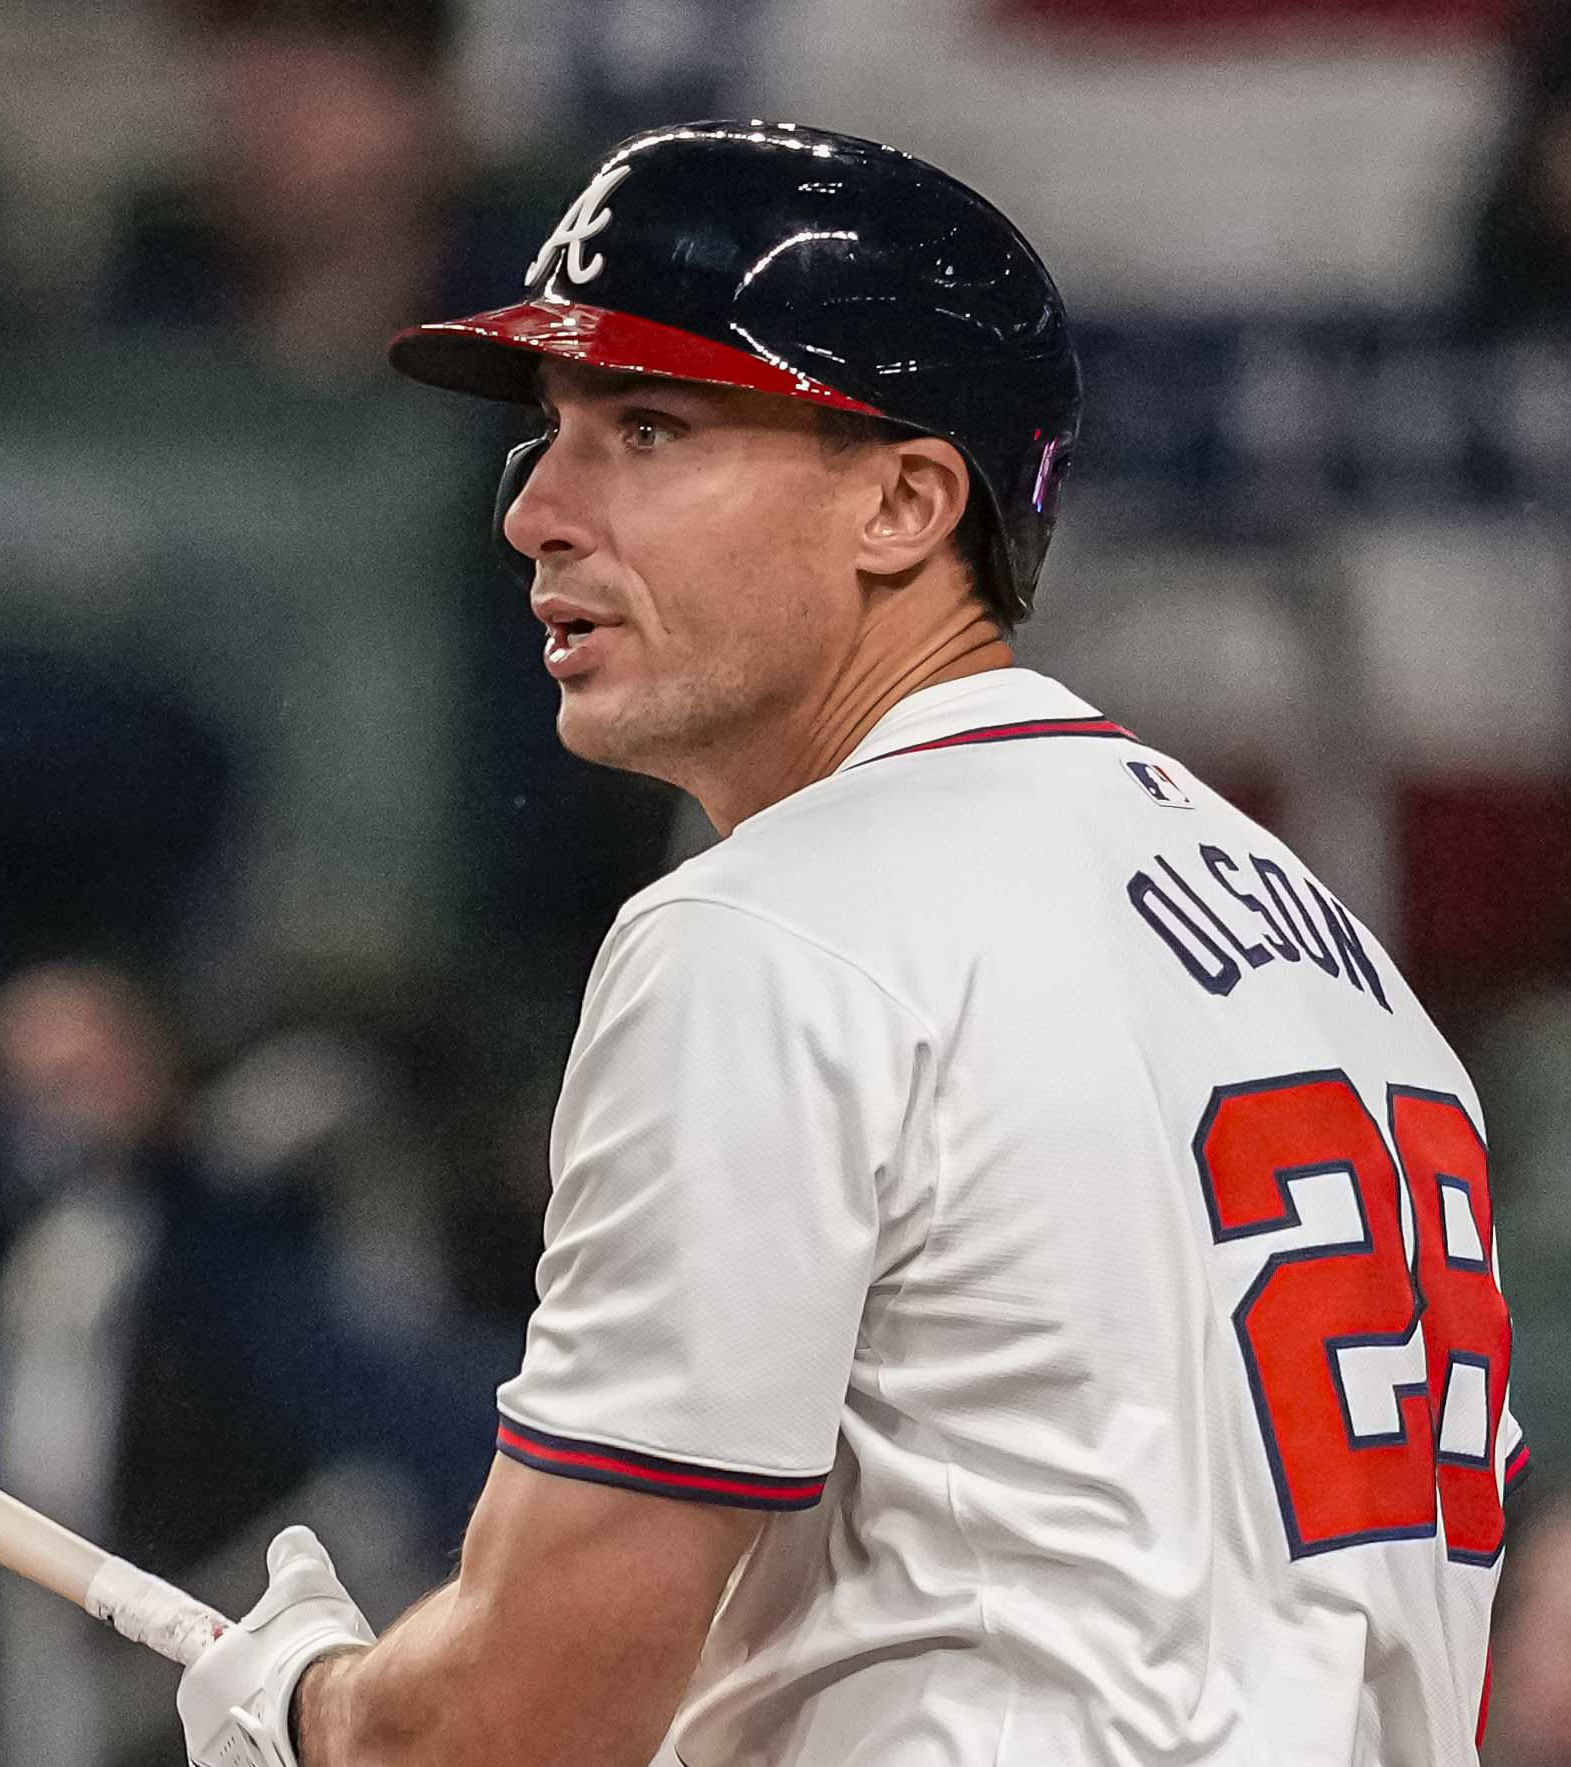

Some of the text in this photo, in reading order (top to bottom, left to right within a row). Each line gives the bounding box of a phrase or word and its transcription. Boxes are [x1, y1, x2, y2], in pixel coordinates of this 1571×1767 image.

[524, 165, 631, 285] A
[1126, 843, 1393, 1014] OLSON
[1191, 1067, 1512, 1568] 28
